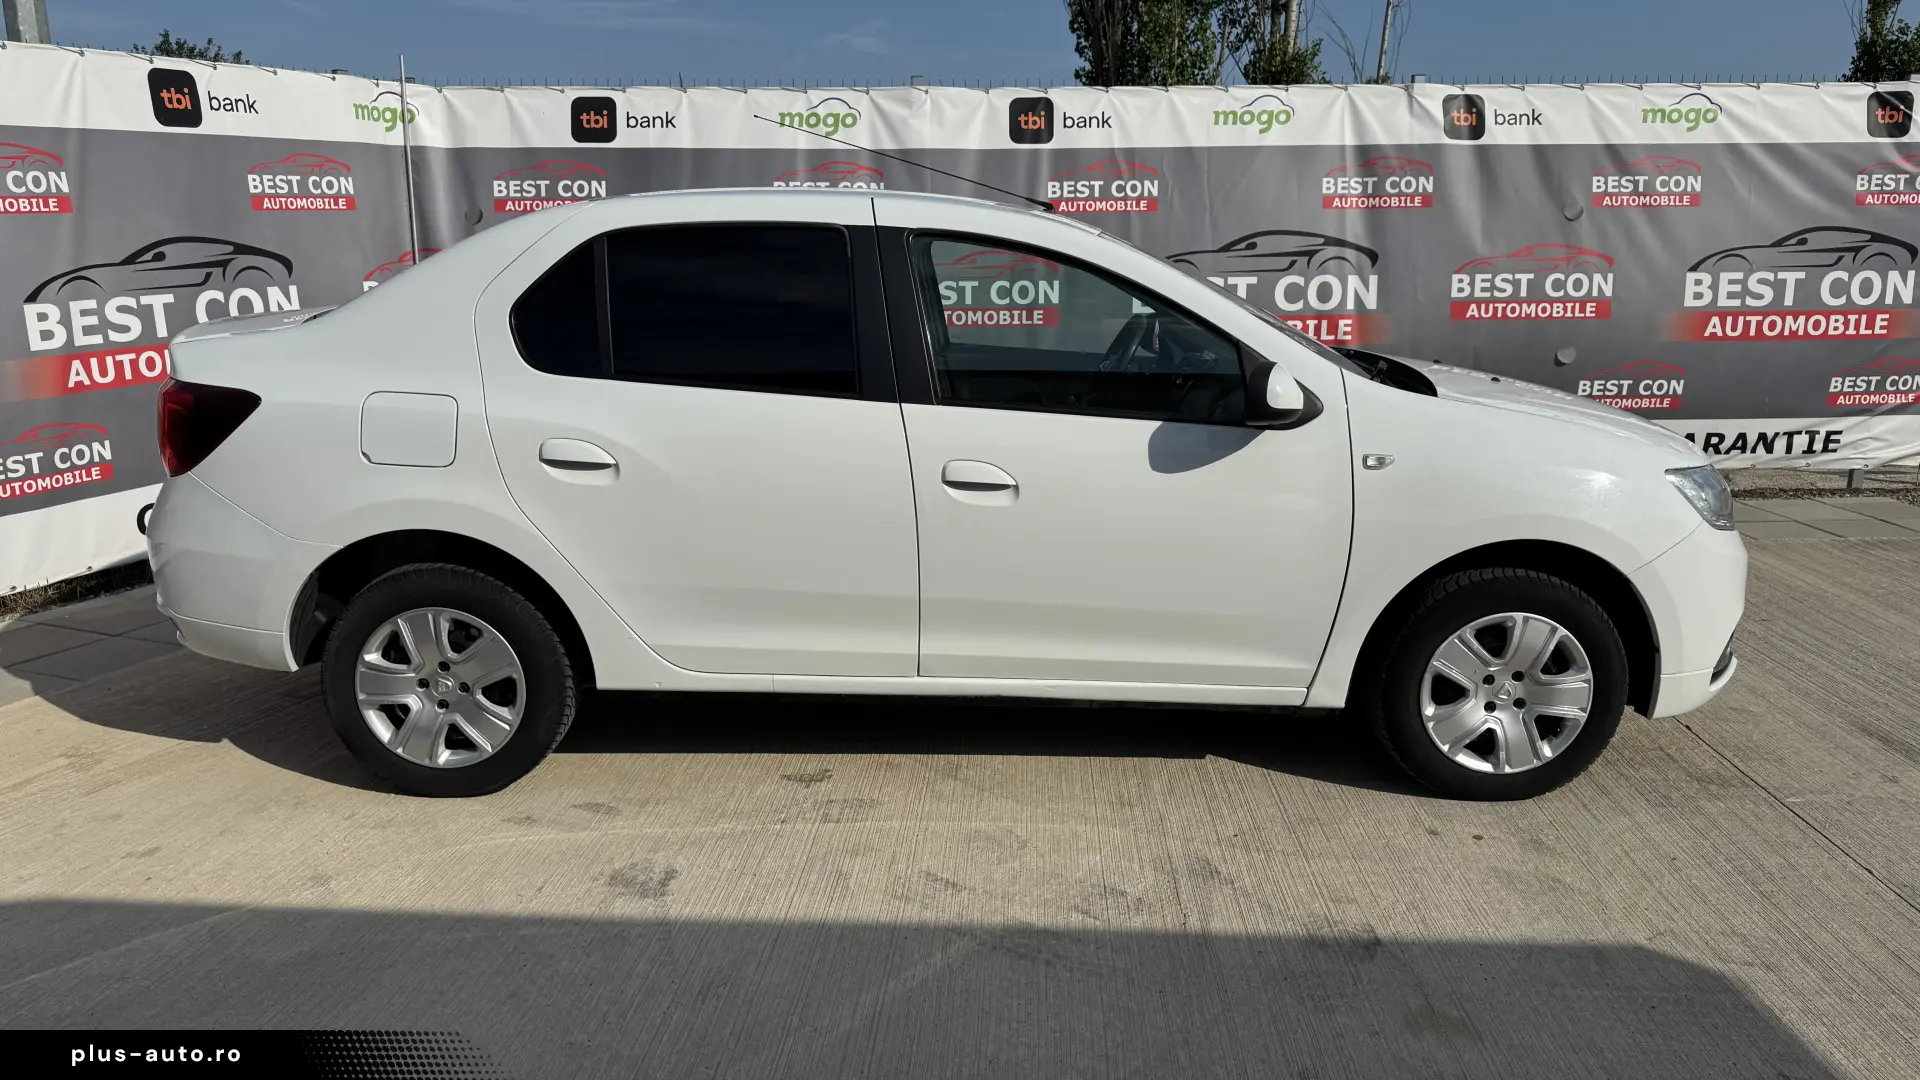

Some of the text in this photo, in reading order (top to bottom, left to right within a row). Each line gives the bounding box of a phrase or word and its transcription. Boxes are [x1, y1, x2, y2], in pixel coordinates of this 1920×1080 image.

[161, 88, 259, 115] tbi bank
[580, 111, 677, 130] tbi bank
[1018, 111, 1113, 131] tbi bank
[1213, 109, 1292, 134] mogo
[1451, 109, 1543, 127] tbi bank
[1642, 107, 1719, 132] mogo
[1875, 105, 1905, 124] tbi
[779, 112, 858, 137] mogo
[6, 170, 70, 194] CON
[247, 174, 355, 195] BEST CON
[493, 180, 607, 198] BEST CON
[1047, 180, 1159, 199] BEST CON
[1321, 176, 1434, 195] BEST CON
[1592, 176, 1702, 194] BEST CON
[1856, 174, 1911, 191] BEST
[263, 198, 347, 210] AUTOMOBILE
[1058, 201, 1148, 213] AUTOMOBILE
[1332, 197, 1422, 209] AUTOMOBILE
[1602, 195, 1692, 207] AUTOMOBILE
[989, 280, 1060, 305] CON
[1274, 274, 1379, 312] CON
[1450, 272, 1615, 299] BEST CON
[1683, 269, 1917, 308] BEST CON
[1465, 302, 1598, 319] AUTOMOBILE
[24, 293, 175, 352] BEST
[1704, 314, 1891, 338] AUTOMOBILE
[67, 348, 170, 388] AUTO
[1577, 379, 1685, 396] BEST CON
[1828, 376, 1882, 393] BEST
[1836, 393, 1916, 405] AUTOMOBILE
[53, 439, 113, 469] CON
